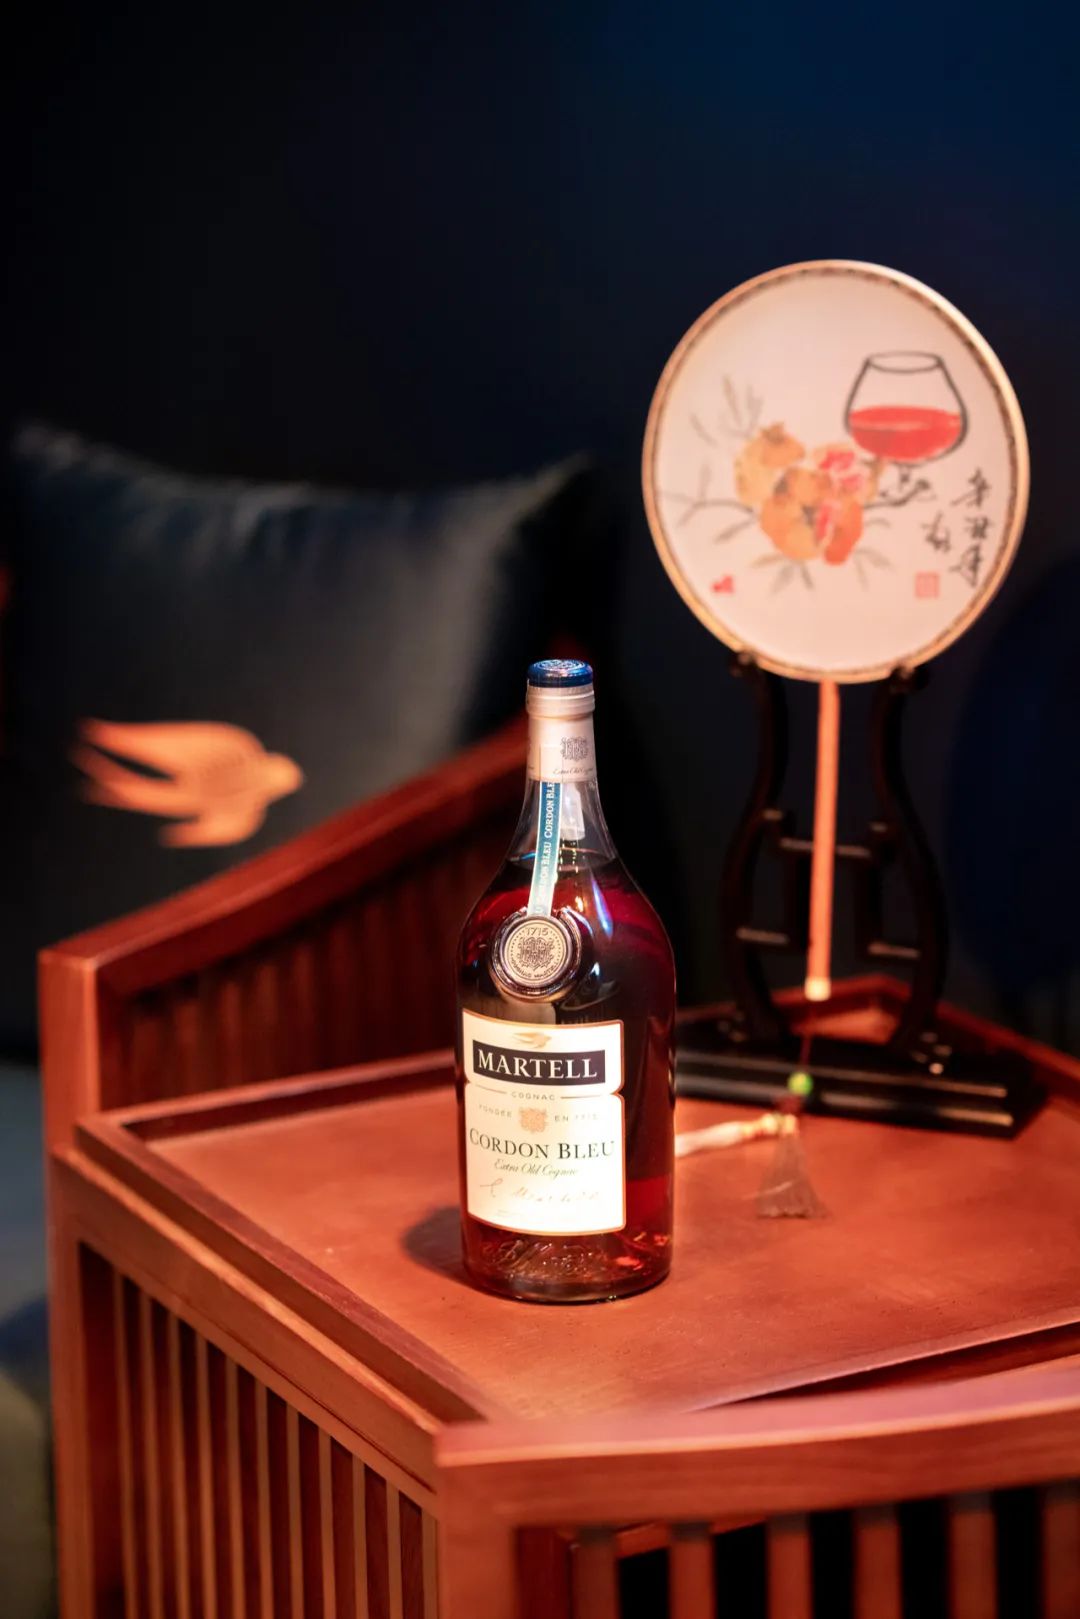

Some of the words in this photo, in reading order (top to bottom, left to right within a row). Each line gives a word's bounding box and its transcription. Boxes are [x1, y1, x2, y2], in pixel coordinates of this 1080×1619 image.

[545, 782, 555, 799] BLE
[543, 800, 555, 838] CORDON
[478, 1049, 598, 1080] MARTELL
[511, 1091, 556, 1101] COGNAC
[469, 1127, 549, 1159] CORDON
[557, 1140, 615, 1160] BLEU
[494, 1158, 519, 1173] Extra
[520, 1162, 542, 1176] Old
[542, 1164, 579, 1180] Cognac
